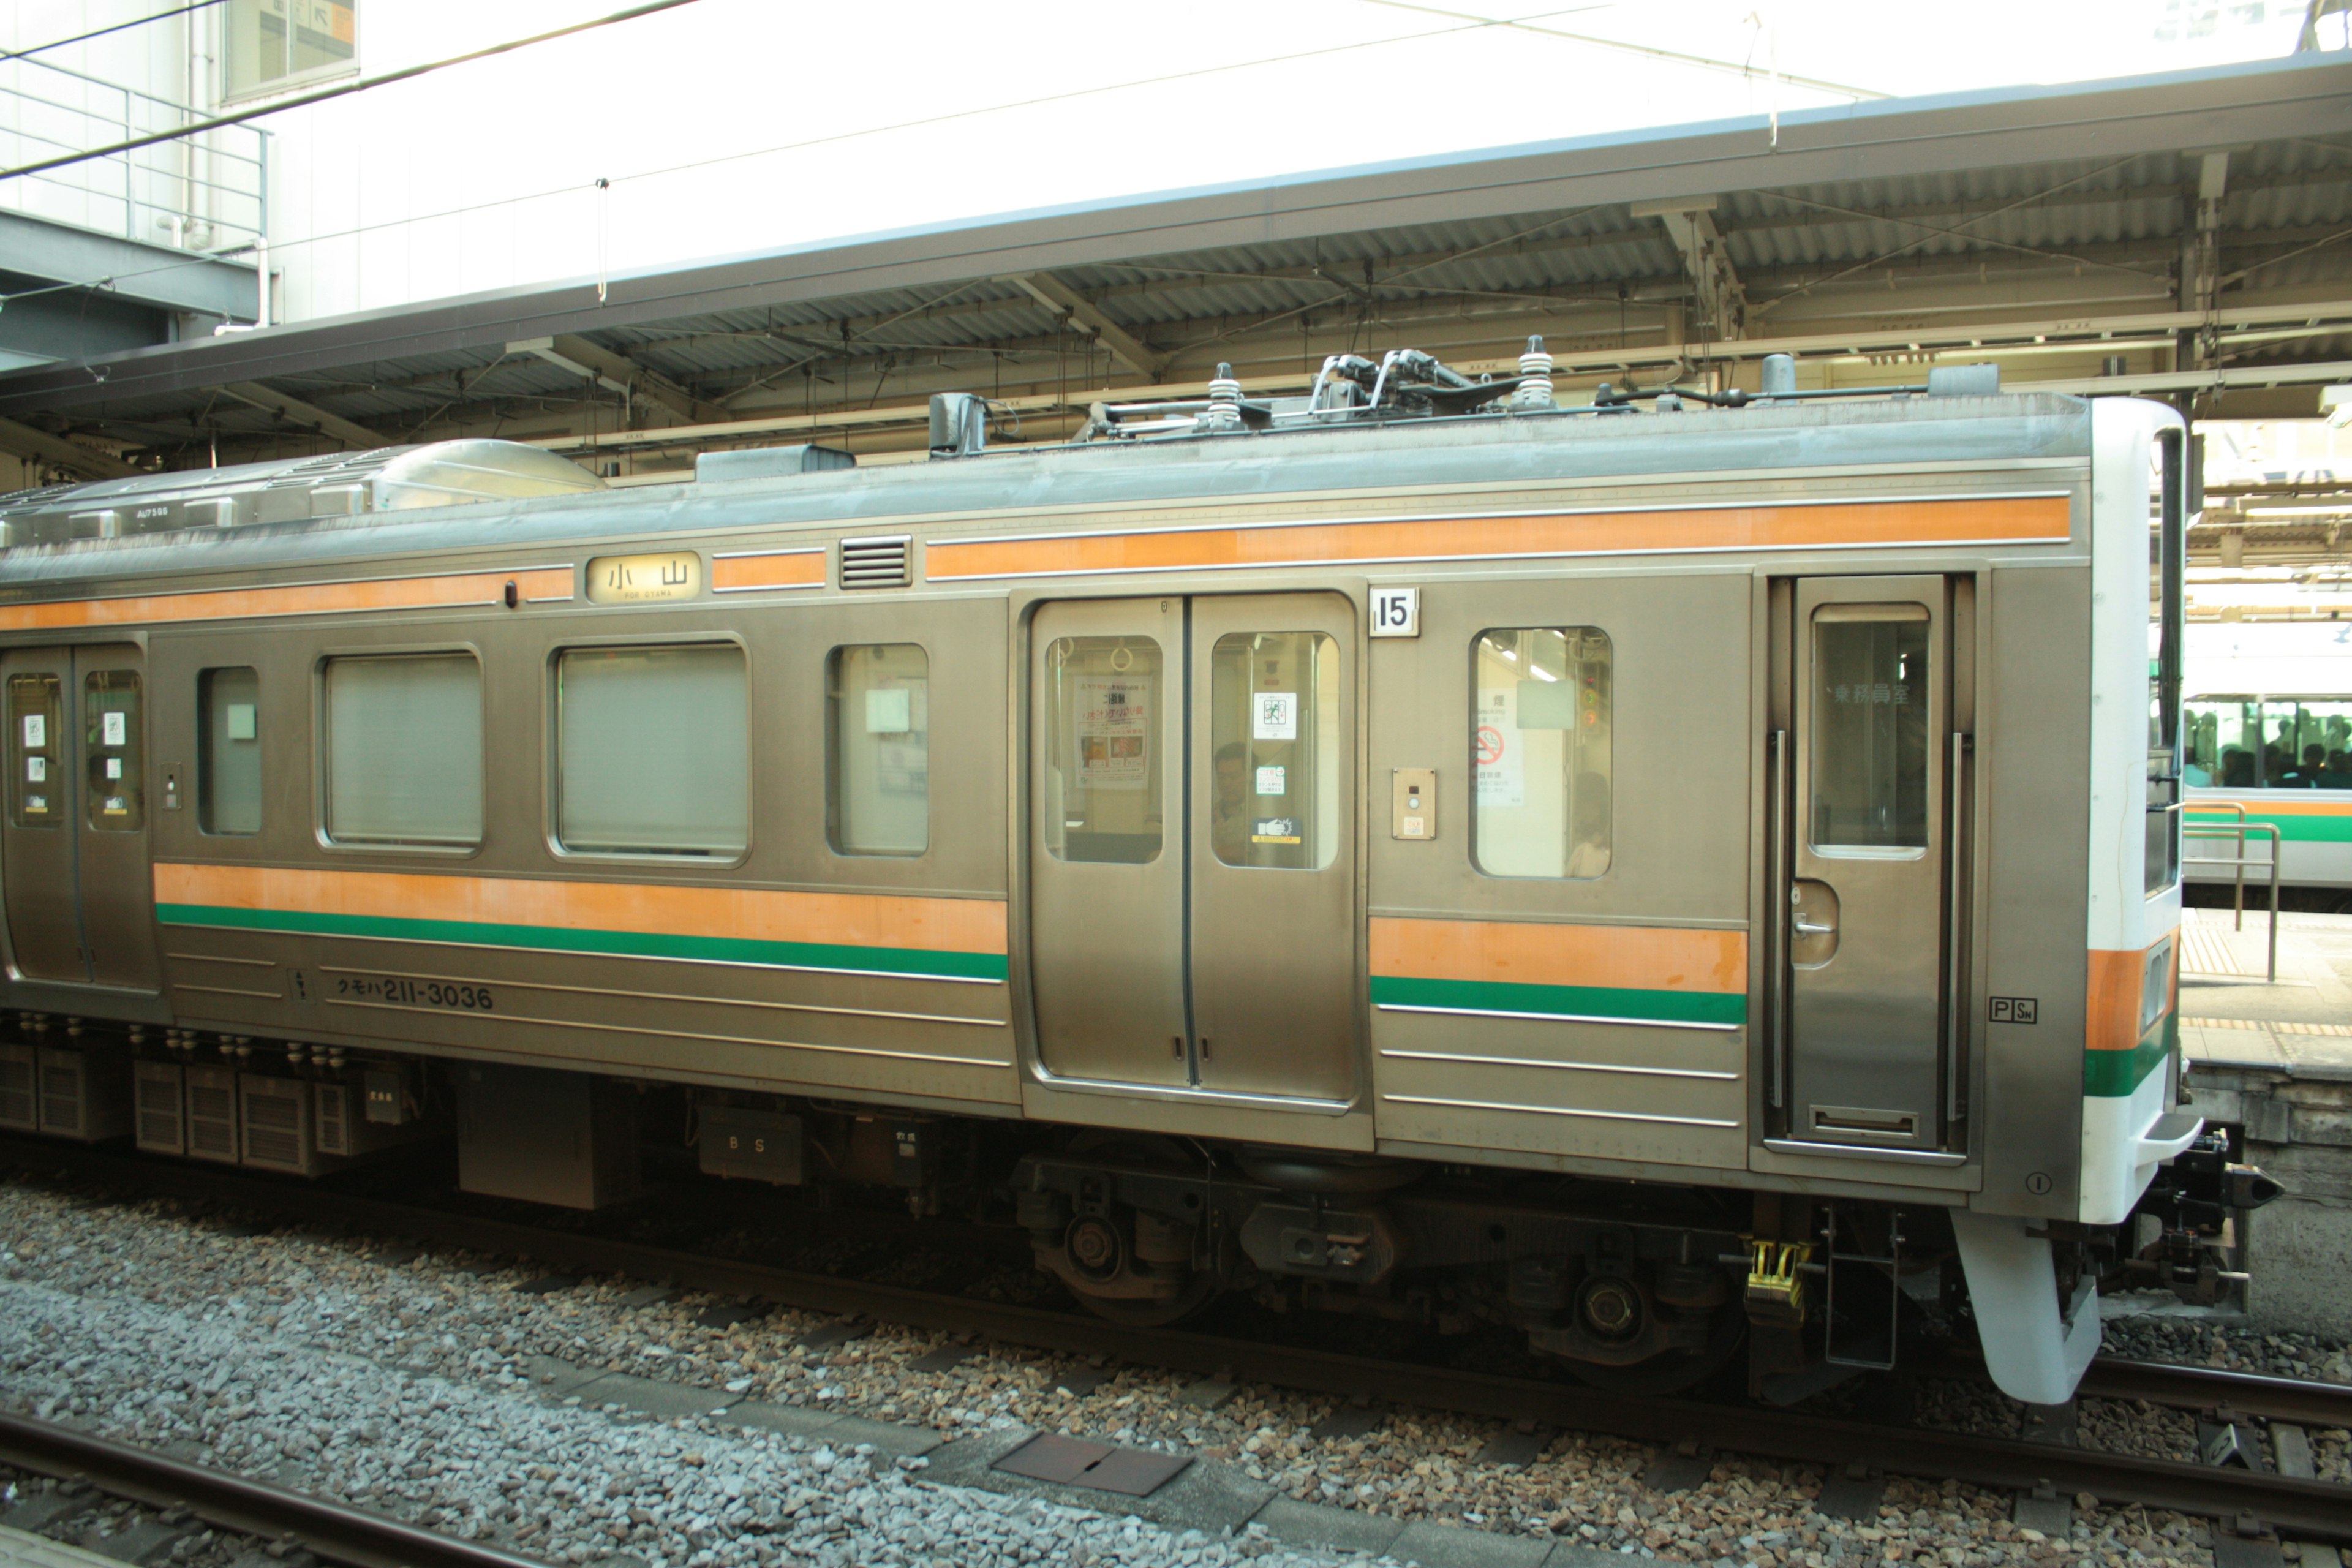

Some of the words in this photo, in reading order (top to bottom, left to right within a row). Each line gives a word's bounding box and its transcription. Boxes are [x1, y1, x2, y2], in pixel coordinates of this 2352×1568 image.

[609, 560, 687, 590] 小山
[645, 590, 672, 598] OYAMA
[1380, 596, 1408, 627] 15
[1835, 684, 1910, 704] 乗務員室
[339, 979, 492, 1009] クモハ211-3036
[1995, 1001, 2009, 1017] P
